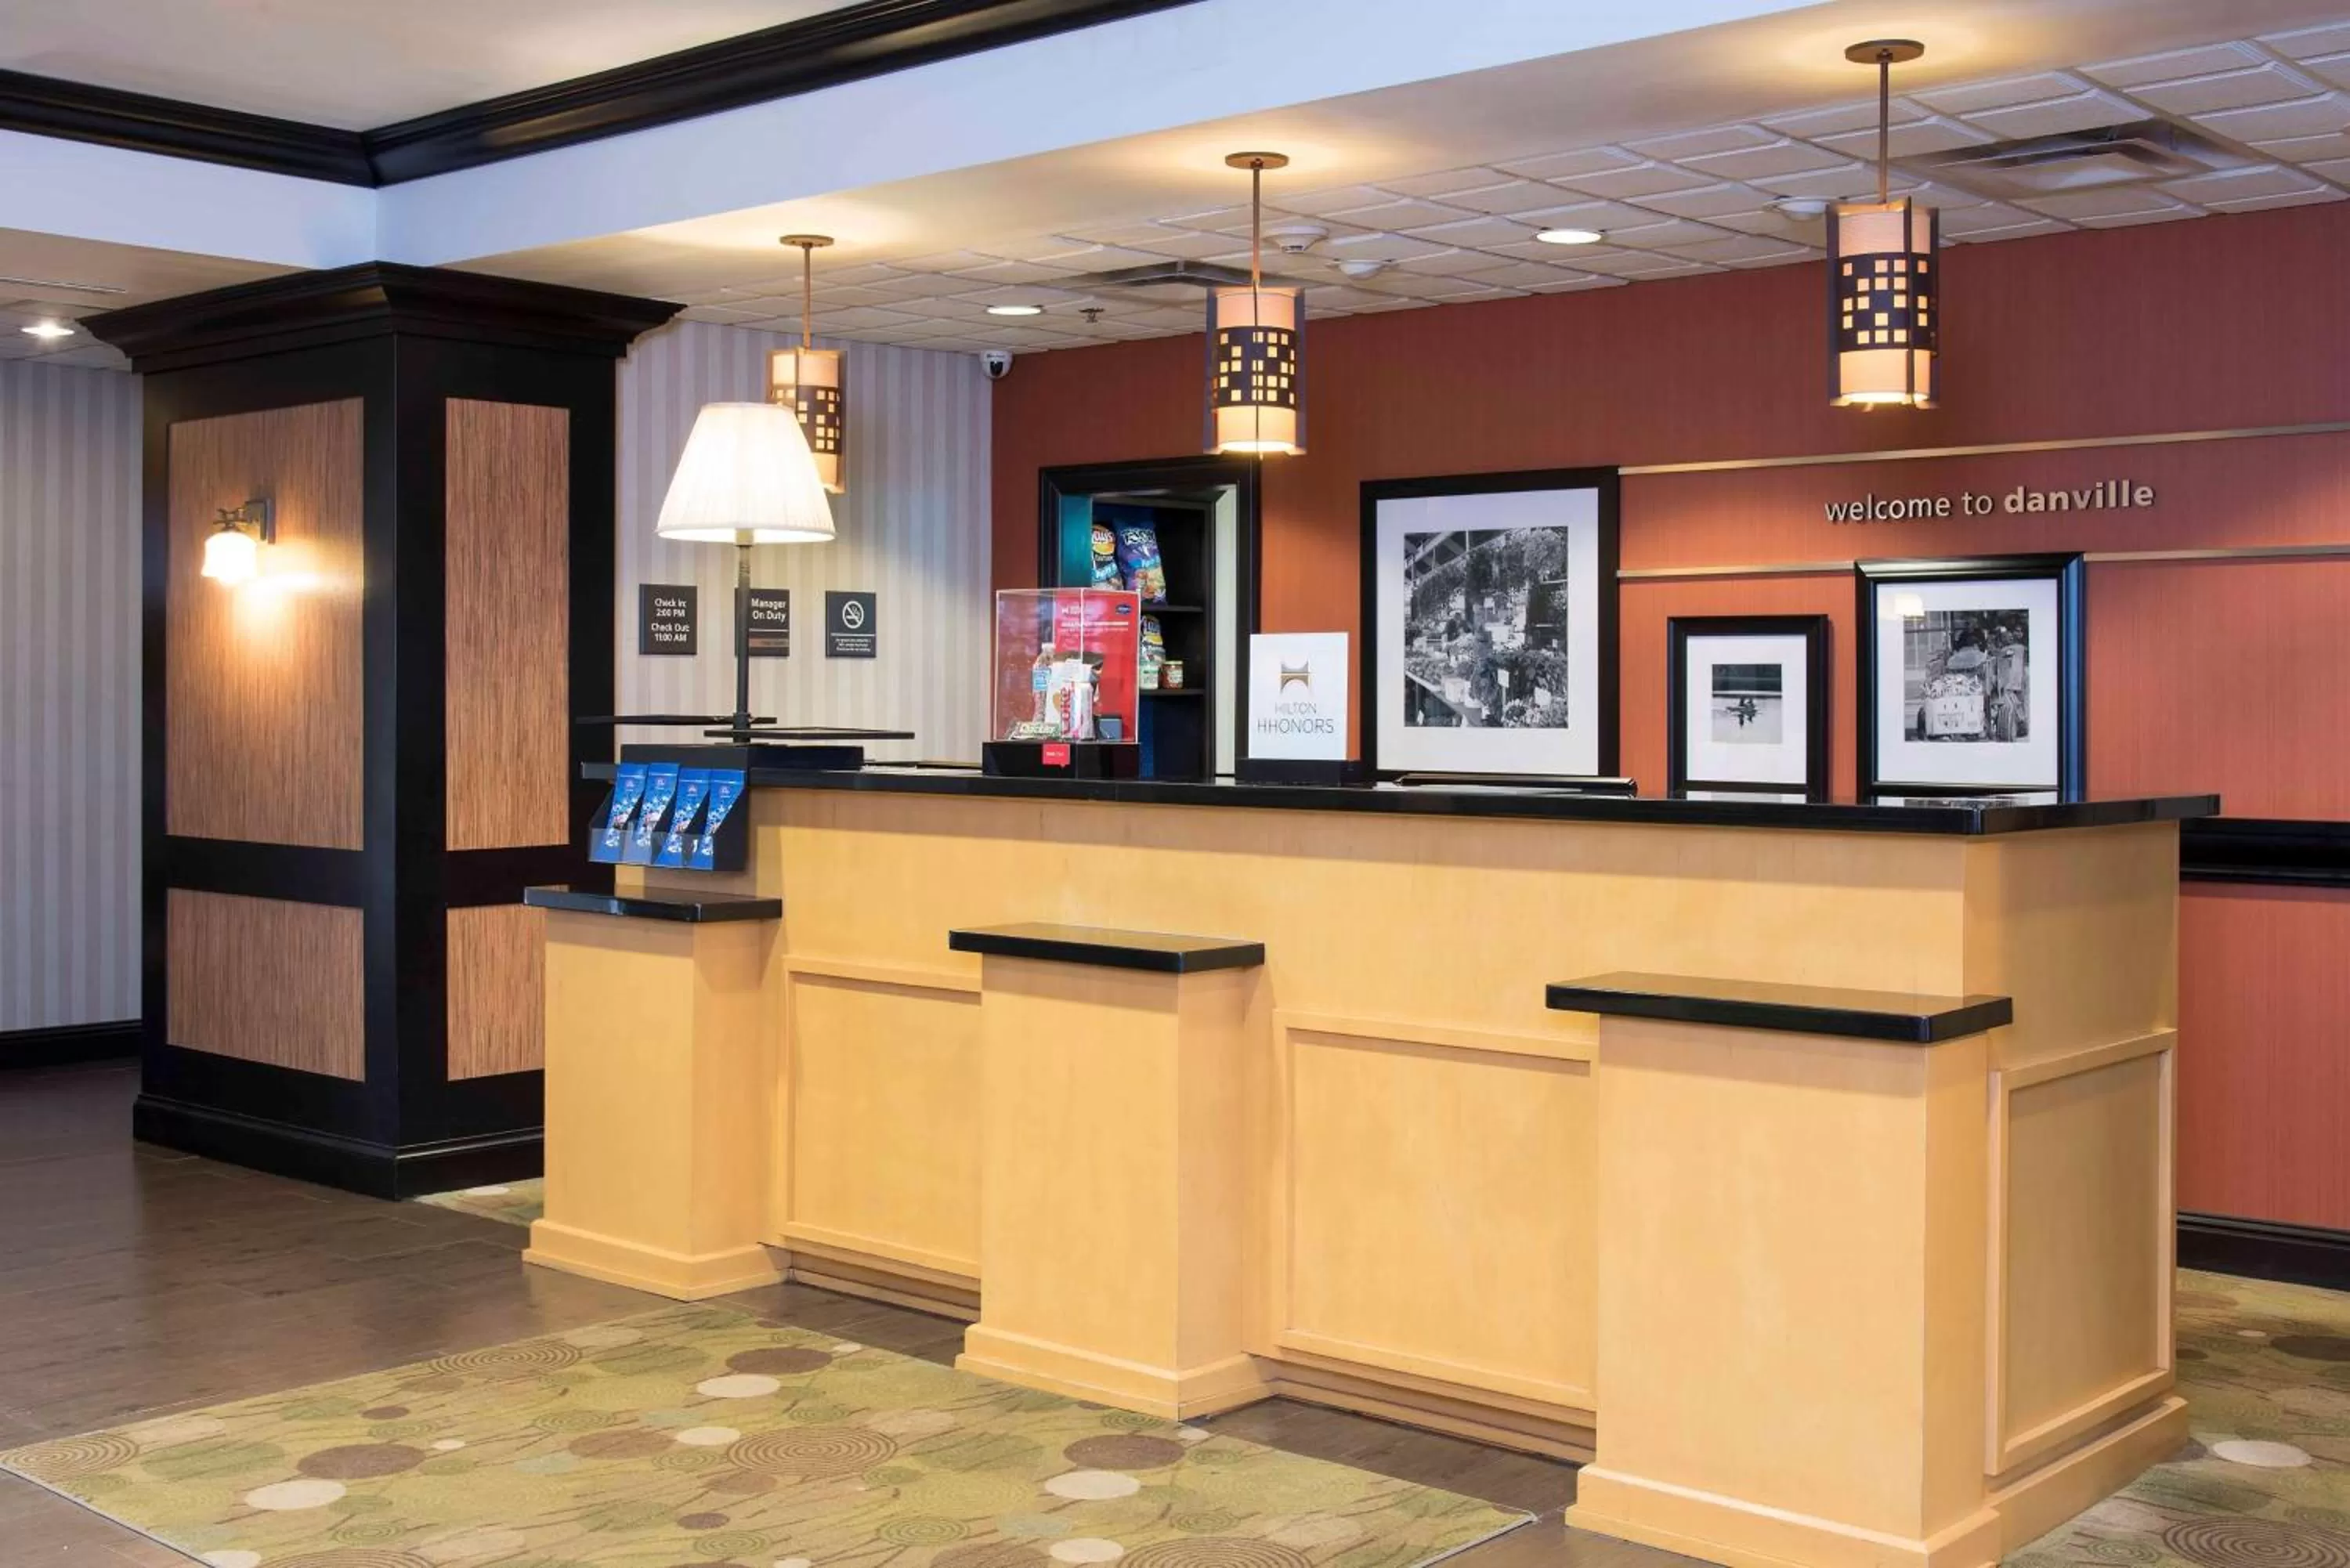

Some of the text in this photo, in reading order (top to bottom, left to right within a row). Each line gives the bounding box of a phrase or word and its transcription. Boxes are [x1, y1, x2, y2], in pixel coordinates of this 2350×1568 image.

[1824, 479, 2154, 522] welcome to danville
[654, 598, 676, 607] Check
[751, 598, 786, 610] Manager
[673, 609, 685, 617] PM
[753, 610, 786, 623] On Duty
[651, 623, 673, 632] Check
[674, 633, 687, 642] AM
[1274, 701, 1317, 715] HILTON
[1257, 718, 1334, 734] HHONORS
